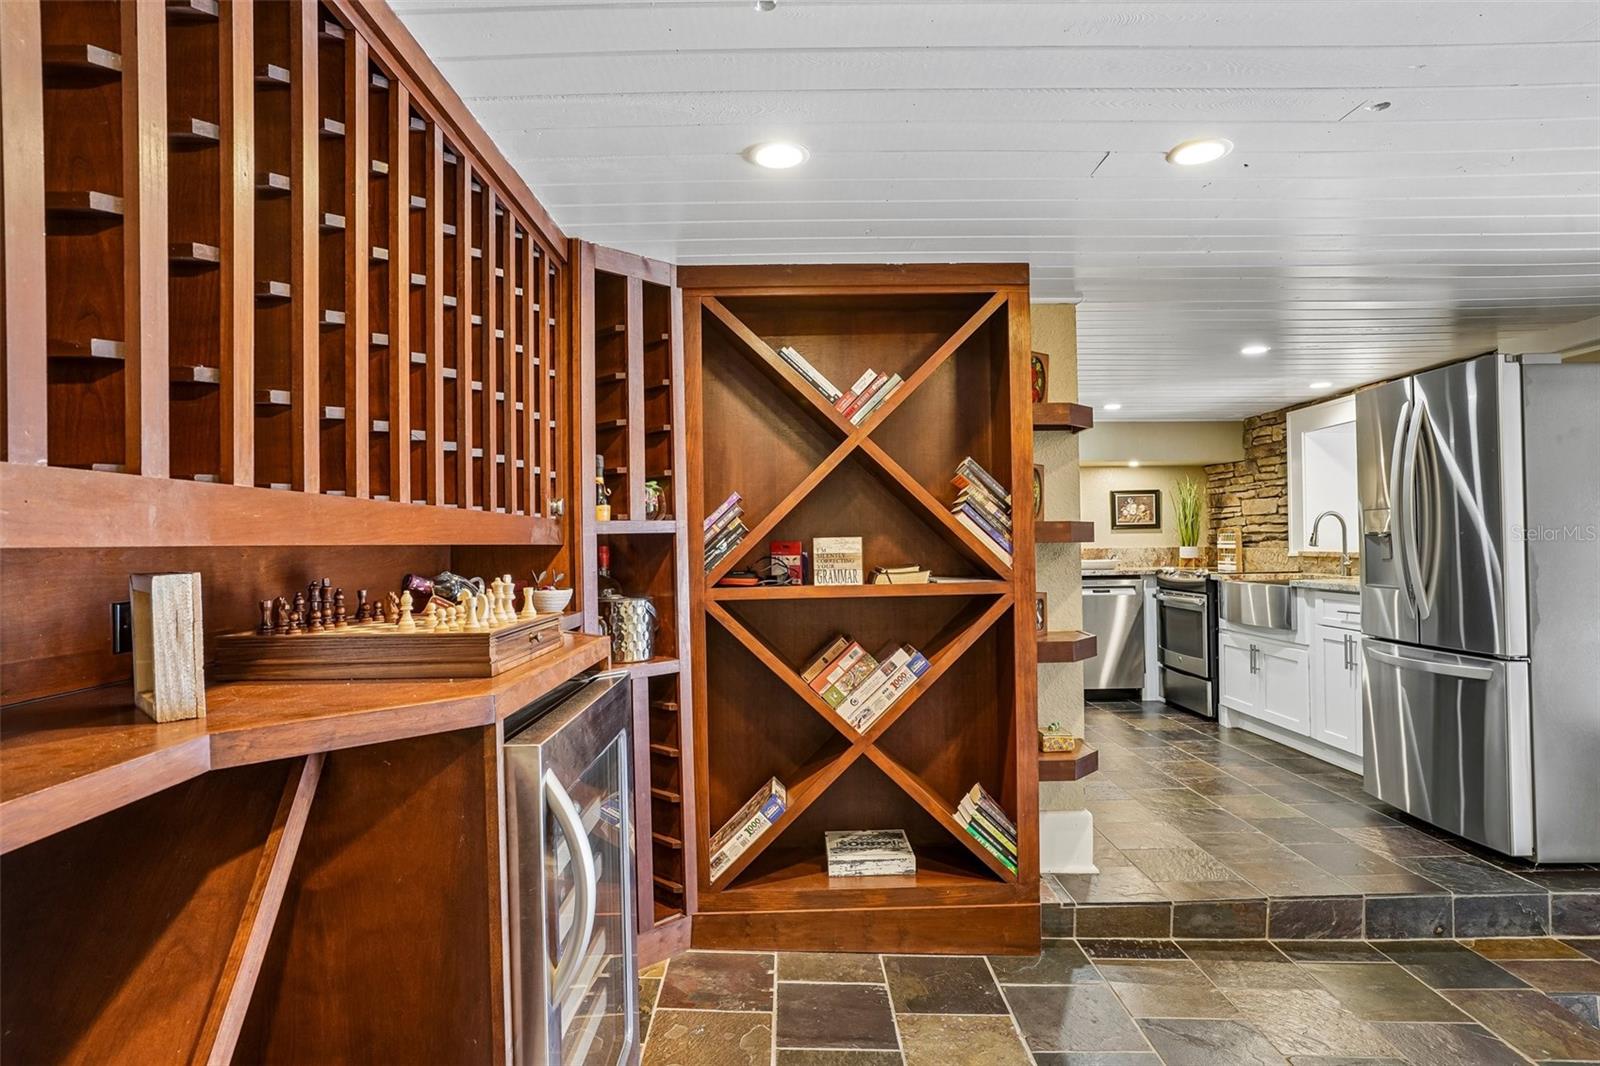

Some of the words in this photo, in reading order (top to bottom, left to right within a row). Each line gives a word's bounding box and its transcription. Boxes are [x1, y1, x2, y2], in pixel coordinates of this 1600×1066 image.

[816, 569, 858, 584] GRAMMAR
[890, 671, 907, 691] 1000
[744, 817, 761, 838] 1000
